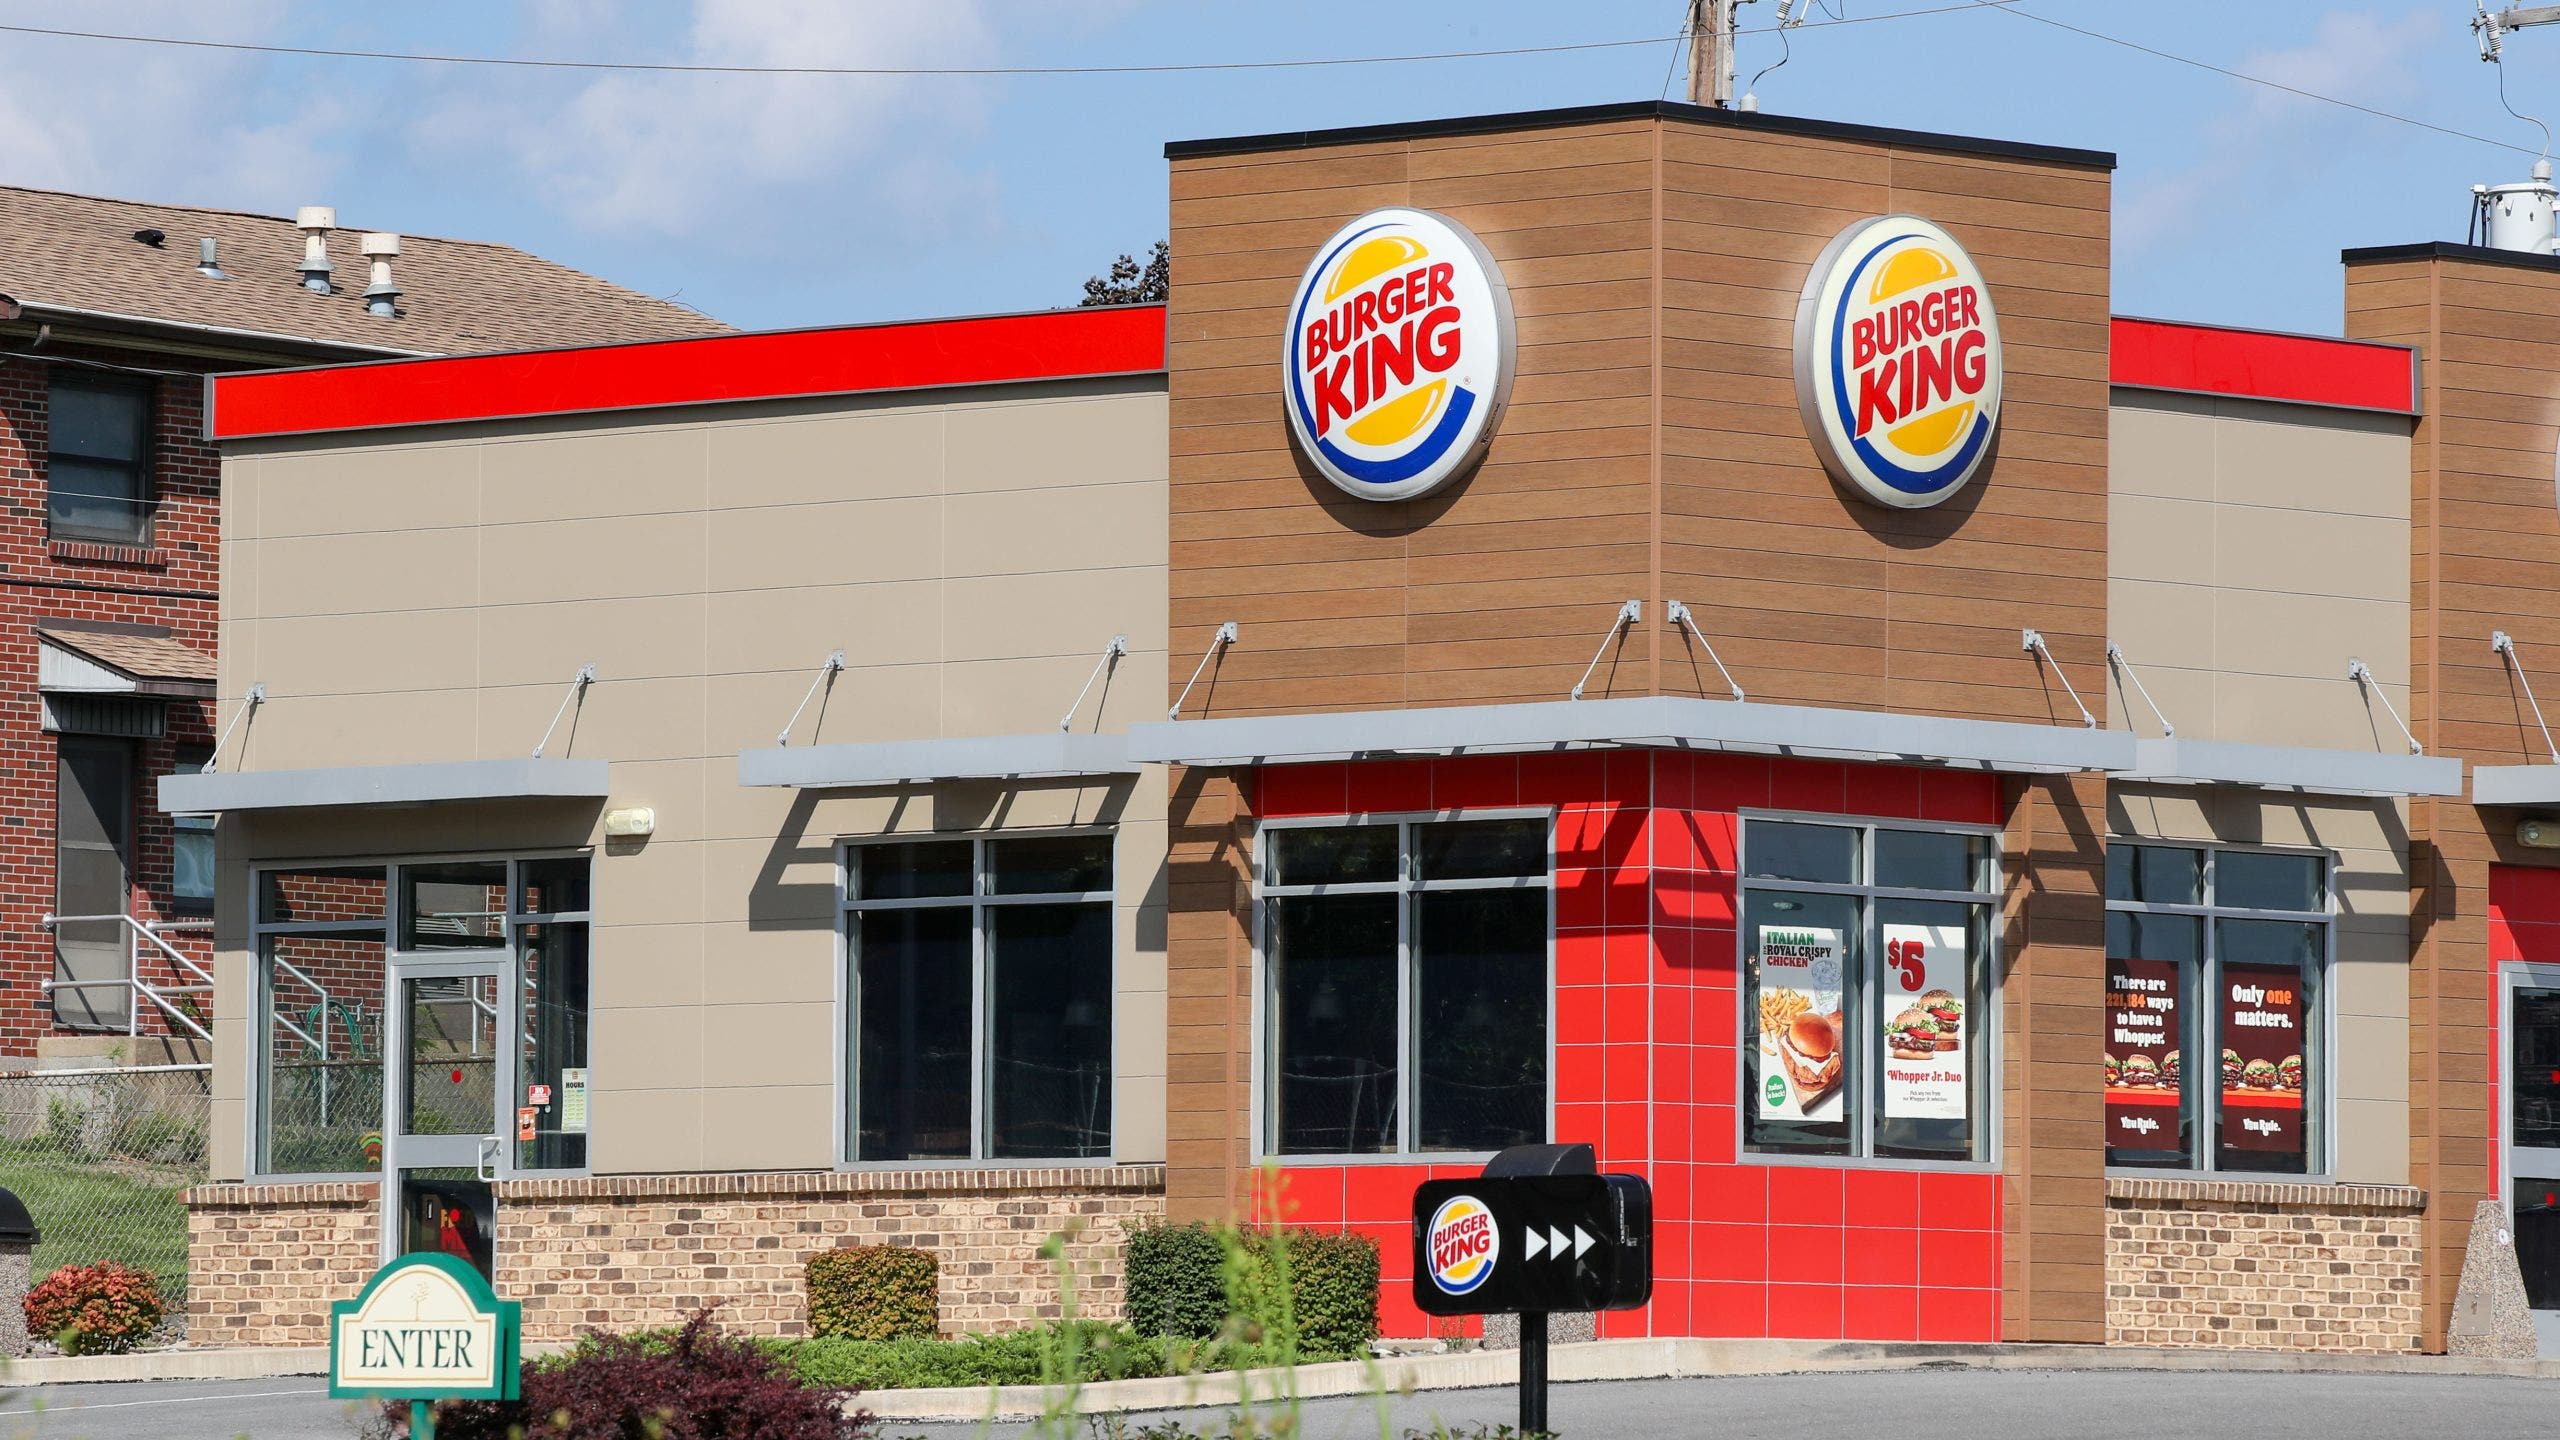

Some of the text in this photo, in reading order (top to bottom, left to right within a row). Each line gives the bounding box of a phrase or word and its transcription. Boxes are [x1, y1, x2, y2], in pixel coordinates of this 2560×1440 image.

[1307, 262, 1455, 373] BURGER
[1852, 285, 1979, 370] BURGER
[1314, 305, 1461, 438] KING
[1855, 329, 1986, 438] KING
[1766, 931, 1815, 946] ITALIAN
[1766, 955, 1808, 967] CHICKEN
[1767, 944, 1831, 961] ROYAL CRISPY
[1888, 938, 1926, 992] $5
[2113, 975, 2166, 991] There are
[2146, 996, 2174, 1013] ways
[2232, 984, 2292, 1008] Only one
[2116, 1010, 2163, 1026] to have a
[2234, 1010, 2293, 1028] matters.
[1887, 1070, 1962, 1083] Whopper Jr. Duo
[2120, 1115, 2160, 1135] You Rule.
[2243, 1118, 2281, 1136] You Rule.
[1435, 1213, 1488, 1250] BURGER
[1436, 1230, 1490, 1274] KING
[360, 1329, 473, 1368] ENTER
